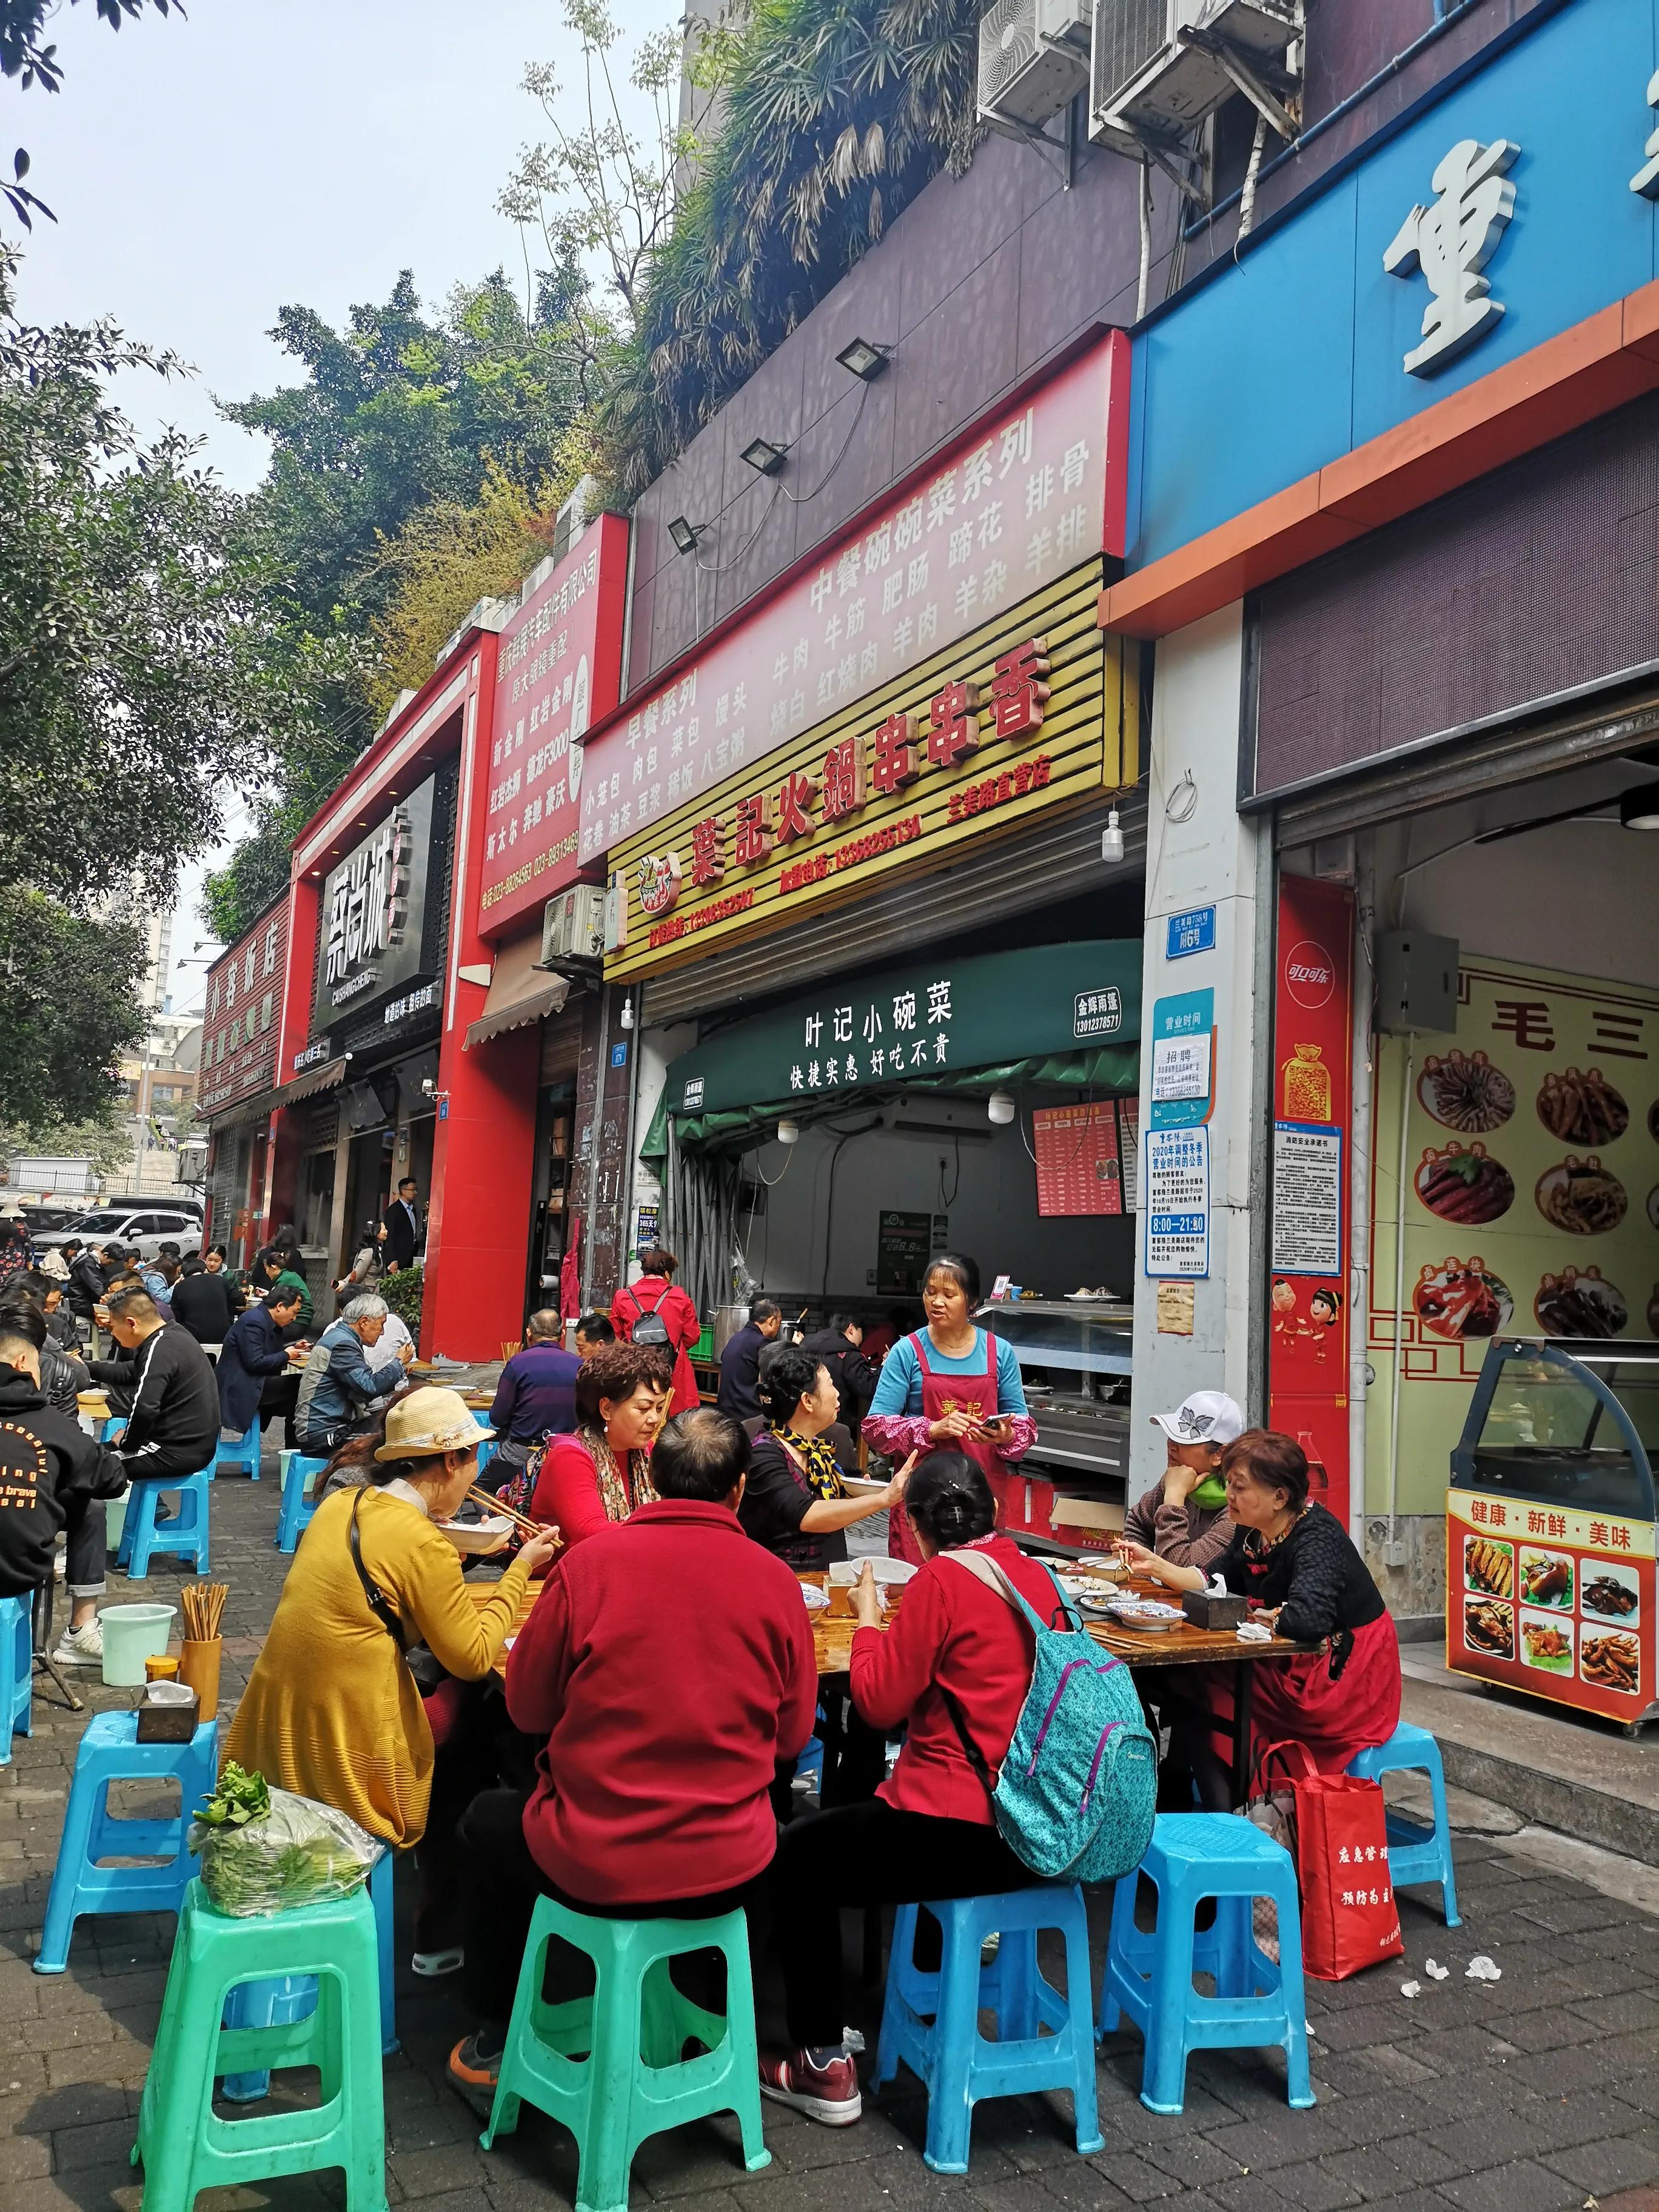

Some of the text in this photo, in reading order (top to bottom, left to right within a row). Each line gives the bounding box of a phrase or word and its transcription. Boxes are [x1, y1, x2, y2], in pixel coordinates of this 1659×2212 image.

[810, 407, 1033, 614] 中餐碗碗菜系列
[773, 438, 1090, 685] 牛肉 牛筋 肥肠 蹄花 排骨
[816, 641, 877, 707] 红烧肉
[893, 602, 938, 656] 羊肉
[954, 558, 1007, 620] 羊杂
[1024, 503, 1087, 576] 羊排
[529, 671, 573, 735] 红岩金刚
[625, 667, 698, 751] 早餐系列
[584, 681, 748, 816] 小笼包 肉包 菜包 馒头
[523, 795, 543, 834] 奔驰
[545, 777, 566, 817] 豪沃
[581, 726, 746, 854] 花卷 油茶 豆浆 稀饭 八宝粥
[947, 754, 1051, 824] 兰美路直营店
[1288, 963, 1330, 985] 可口可乐
[805, 980, 953, 1048] 叶记小碗菜
[1076, 1013, 1119, 1034] 13012378571
[1078, 991, 1118, 1017] 金辉雨篷
[1165, 1011, 1201, 1031] 营业时间
[1492, 999, 1649, 1061] 毛三
[789, 1032, 950, 1090] 快捷实惠 好吃不贵
[1166, 1048, 1191, 1064] 招聘
[1152, 1141, 1203, 1158] 2020年调整冬季
[1153, 1156, 1204, 1170] 营业时间的公告
[1285, 1136, 1329, 1147] 消防安全承诺书
[1425, 1141, 1483, 1162] 卤牛肉
[1341, 1885, 1394, 1906] 预防为主
